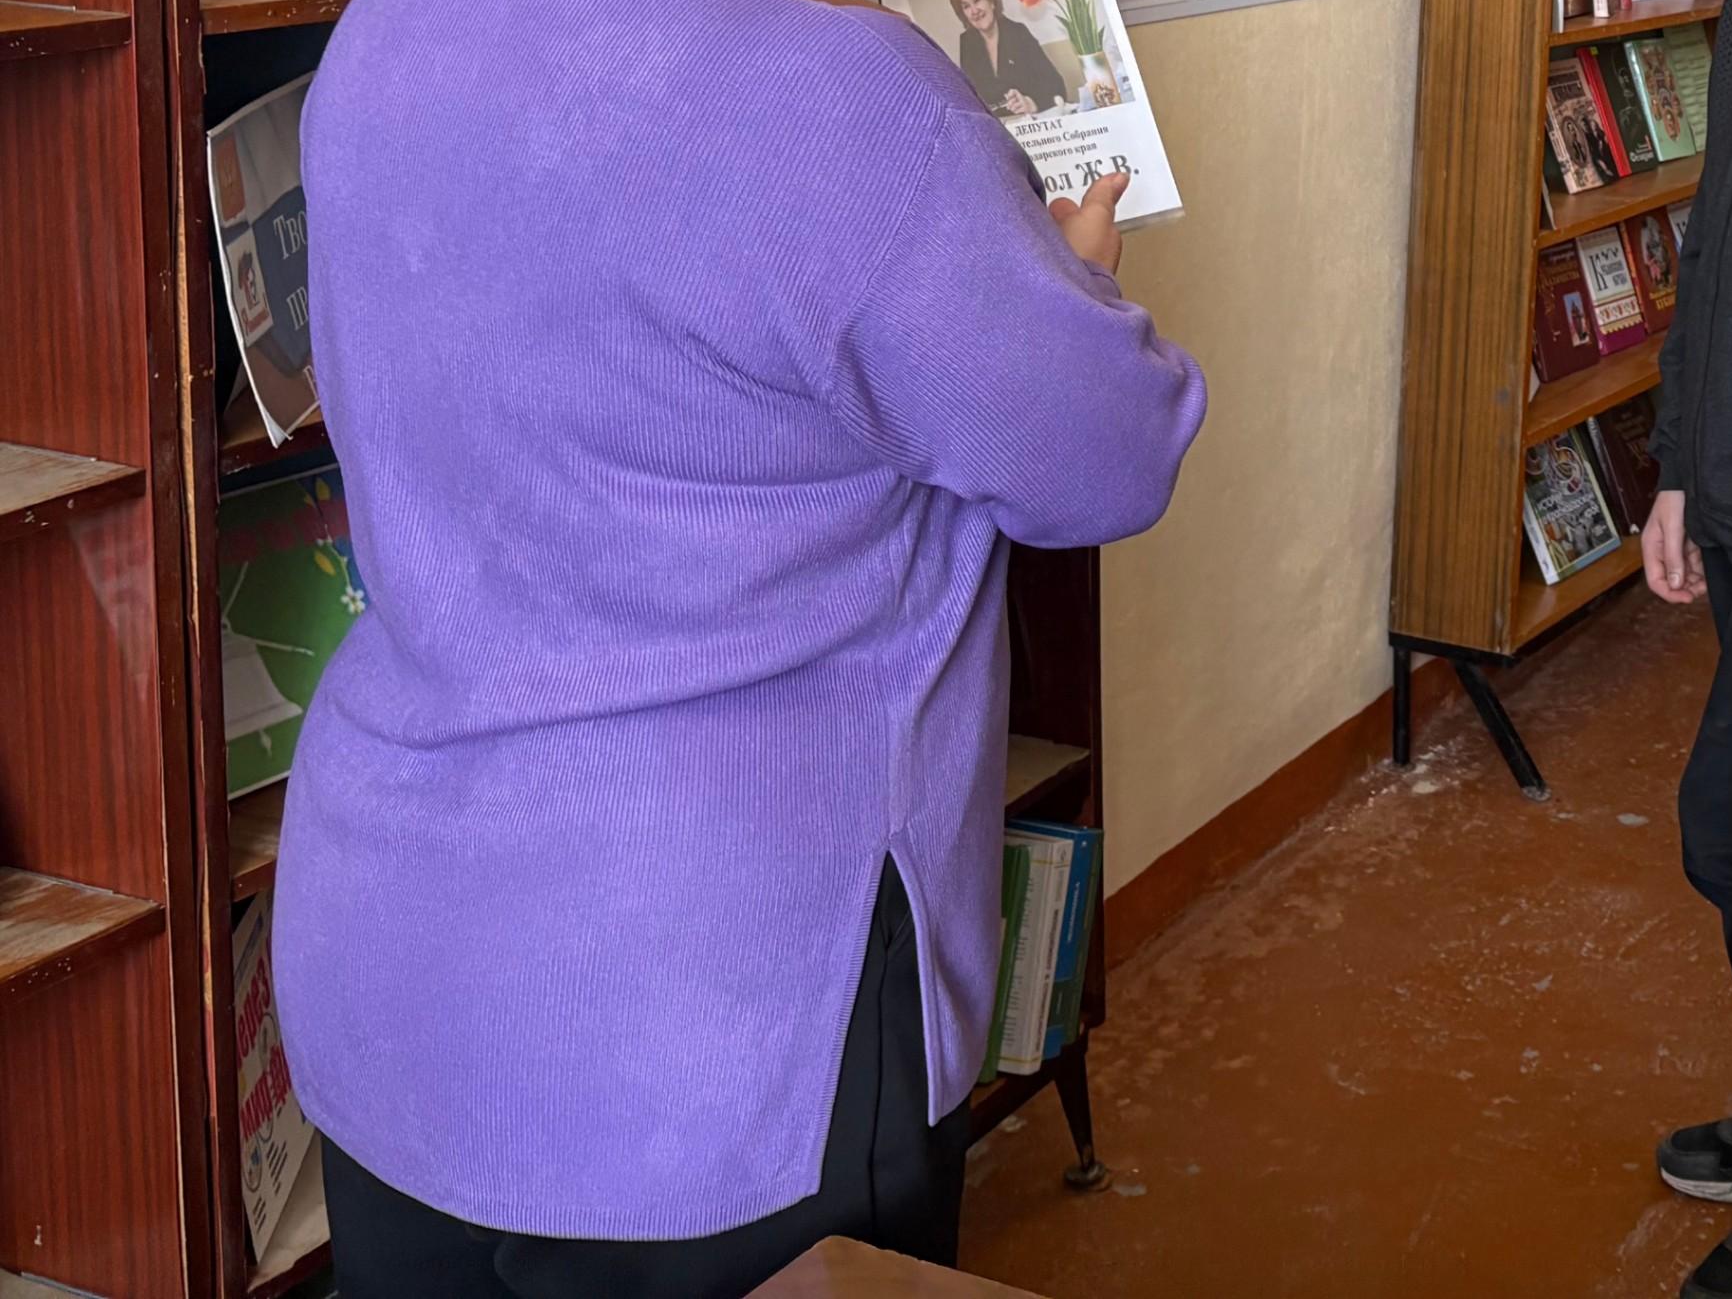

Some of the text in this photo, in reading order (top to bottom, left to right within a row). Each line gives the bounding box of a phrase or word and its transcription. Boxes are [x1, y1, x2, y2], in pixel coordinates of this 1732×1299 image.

[1015, 118, 1063, 137] ДЕПУТАТ
[1021, 125, 1109, 149] тельного Собрания
[1029, 142, 1097, 162] одарского края
